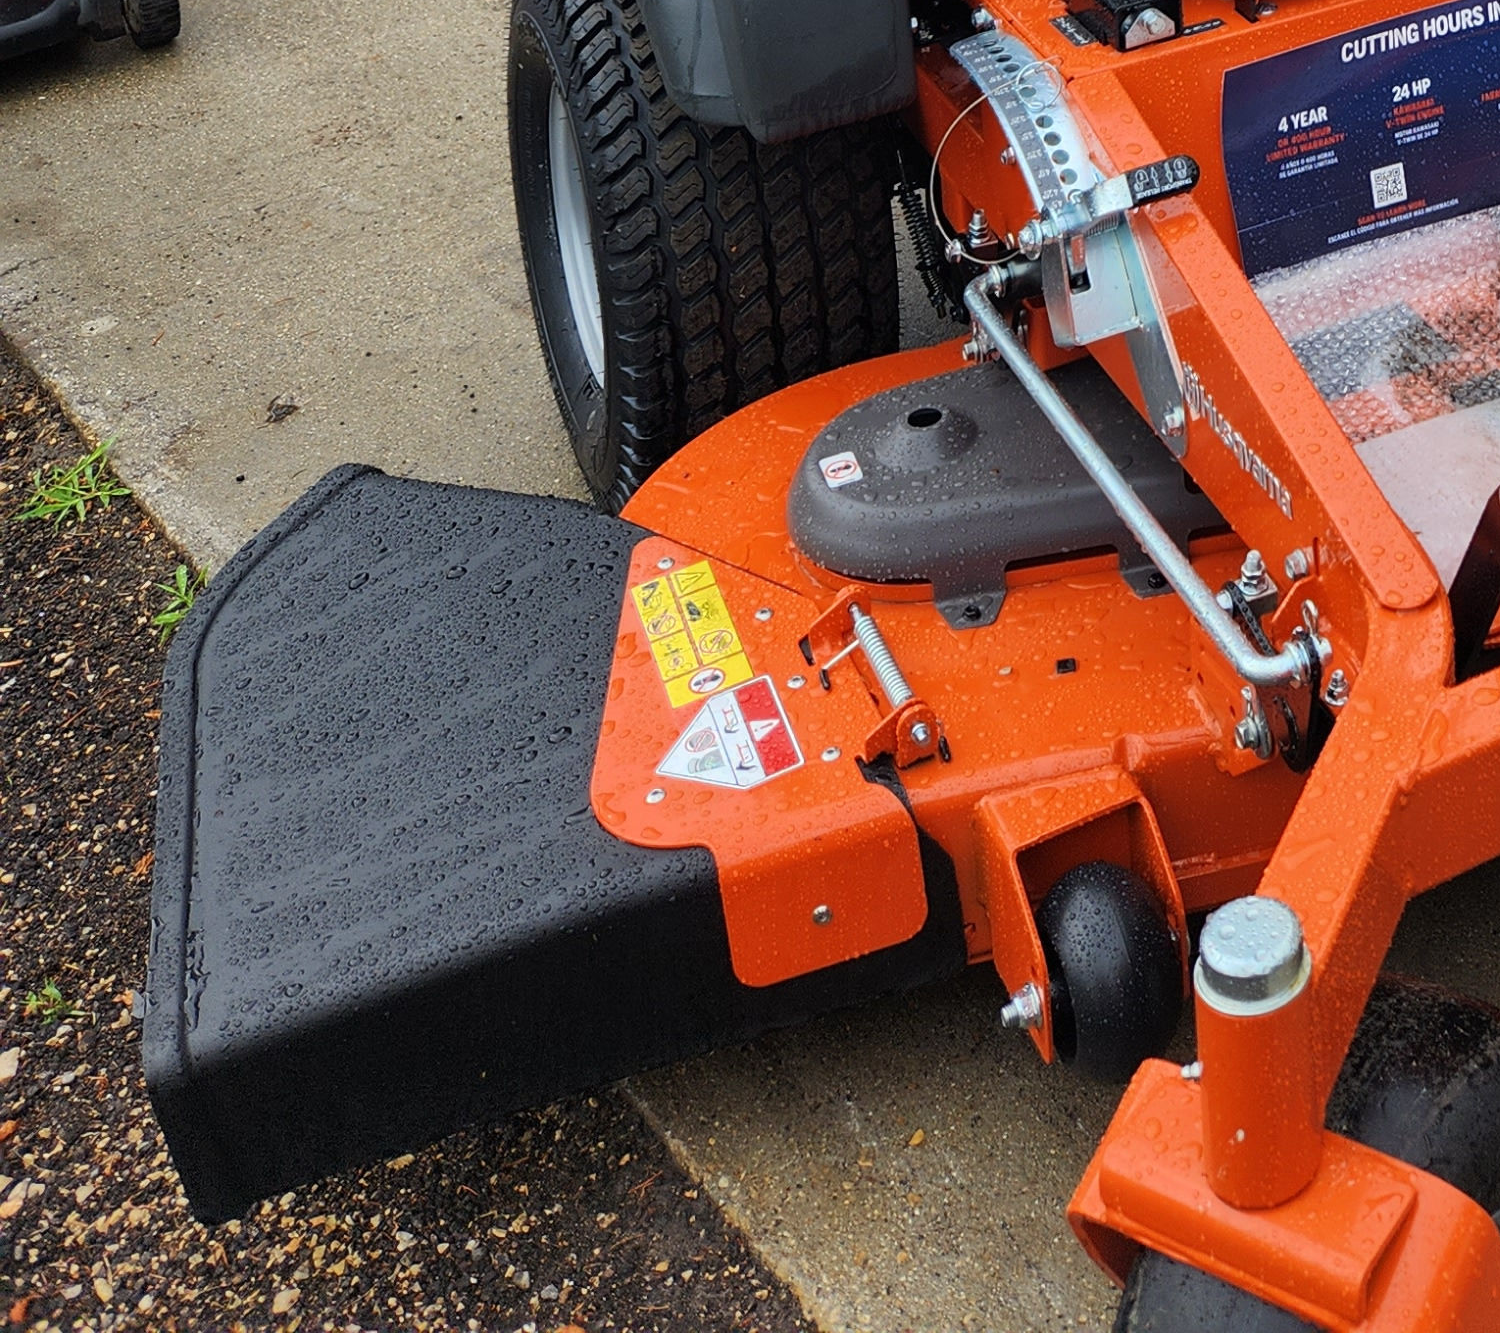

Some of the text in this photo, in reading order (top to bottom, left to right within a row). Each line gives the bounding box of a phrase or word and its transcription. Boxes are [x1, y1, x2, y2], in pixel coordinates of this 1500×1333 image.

[1341, 23, 1420, 64] CUTTING
[1423, 4, 1485, 41] HOURS
[1391, 77, 1432, 103] 24 HP
[1277, 105, 1329, 134] 4 YEAR
[1385, 104, 1446, 131] V-TWIN ENGINE
[1392, 97, 1436, 116] KAWASAKI
[1265, 133, 1346, 163] LIMITED WARRANTY
[1277, 125, 1333, 149] OR 400 HOUR
[1357, 216, 1377, 227] SCAN
[1386, 205, 1407, 218] LEARN
[1407, 198, 1428, 213] MORE
[1199, 383, 1295, 521] Husqvarna
